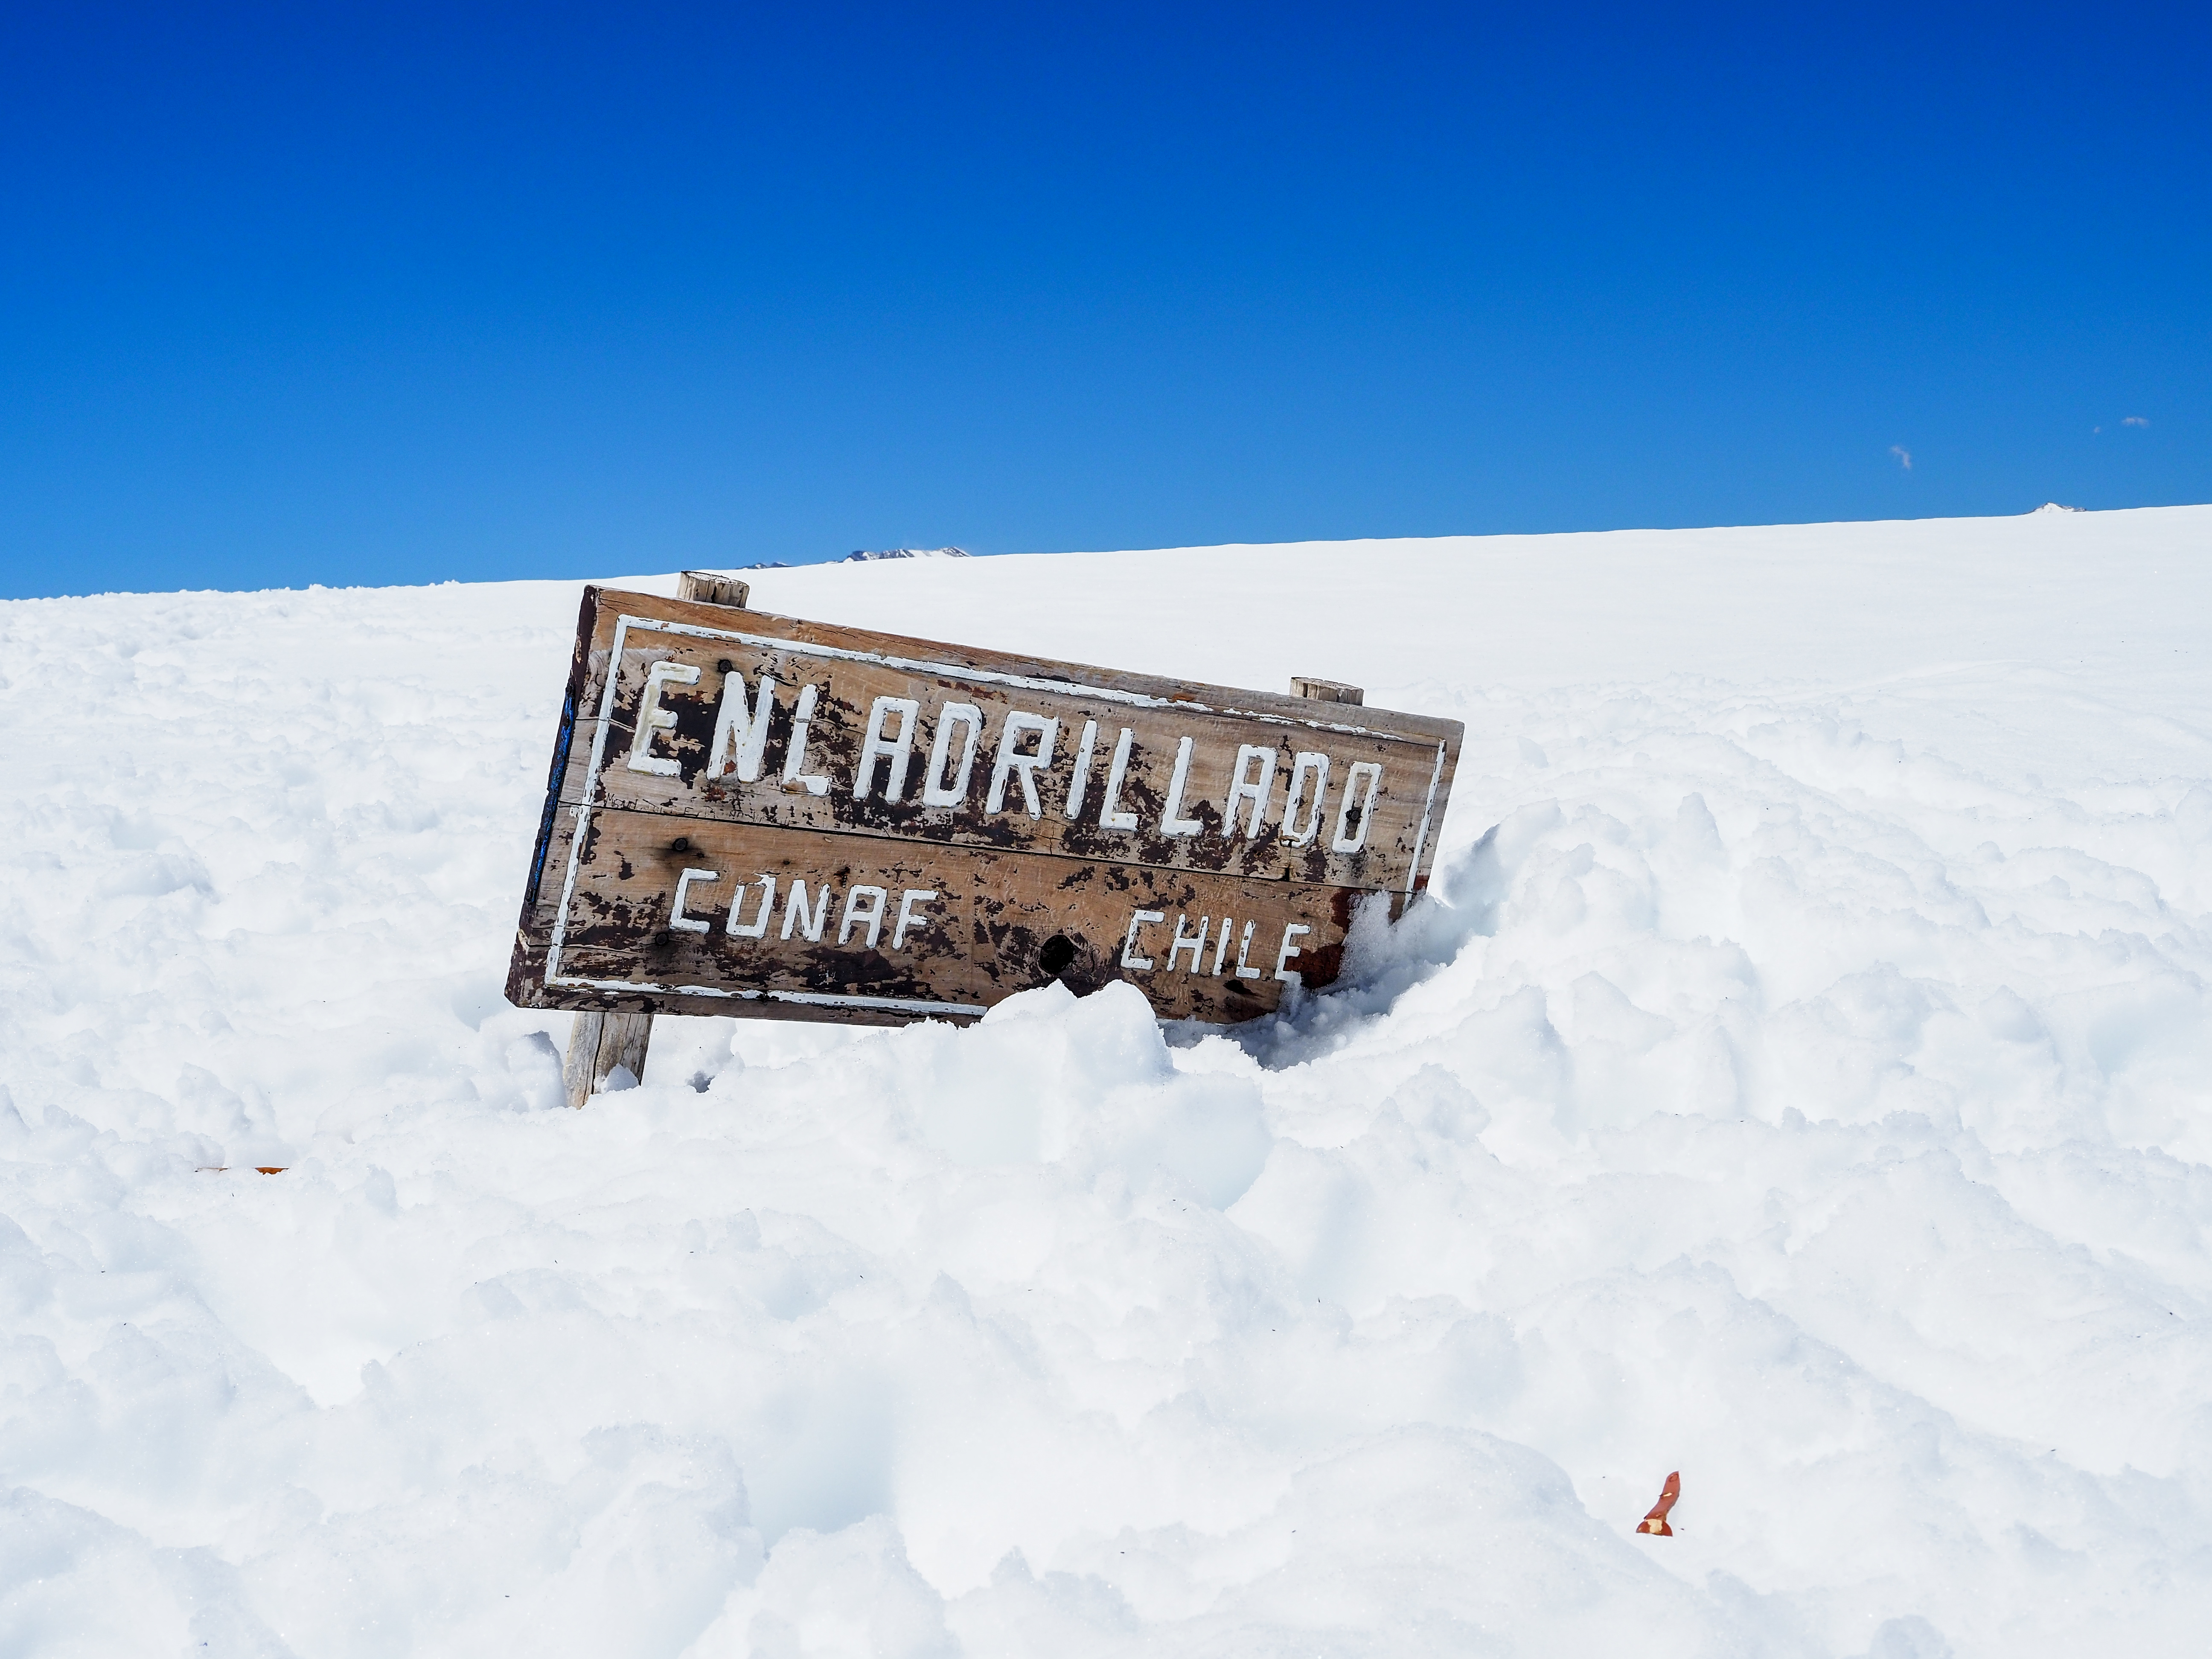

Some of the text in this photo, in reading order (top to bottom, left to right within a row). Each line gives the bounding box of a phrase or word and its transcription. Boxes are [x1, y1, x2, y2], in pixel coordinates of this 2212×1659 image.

[627, 661, 1383, 853] ENLADRILLADO
[669, 867, 1310, 981] CONAF CHILE
